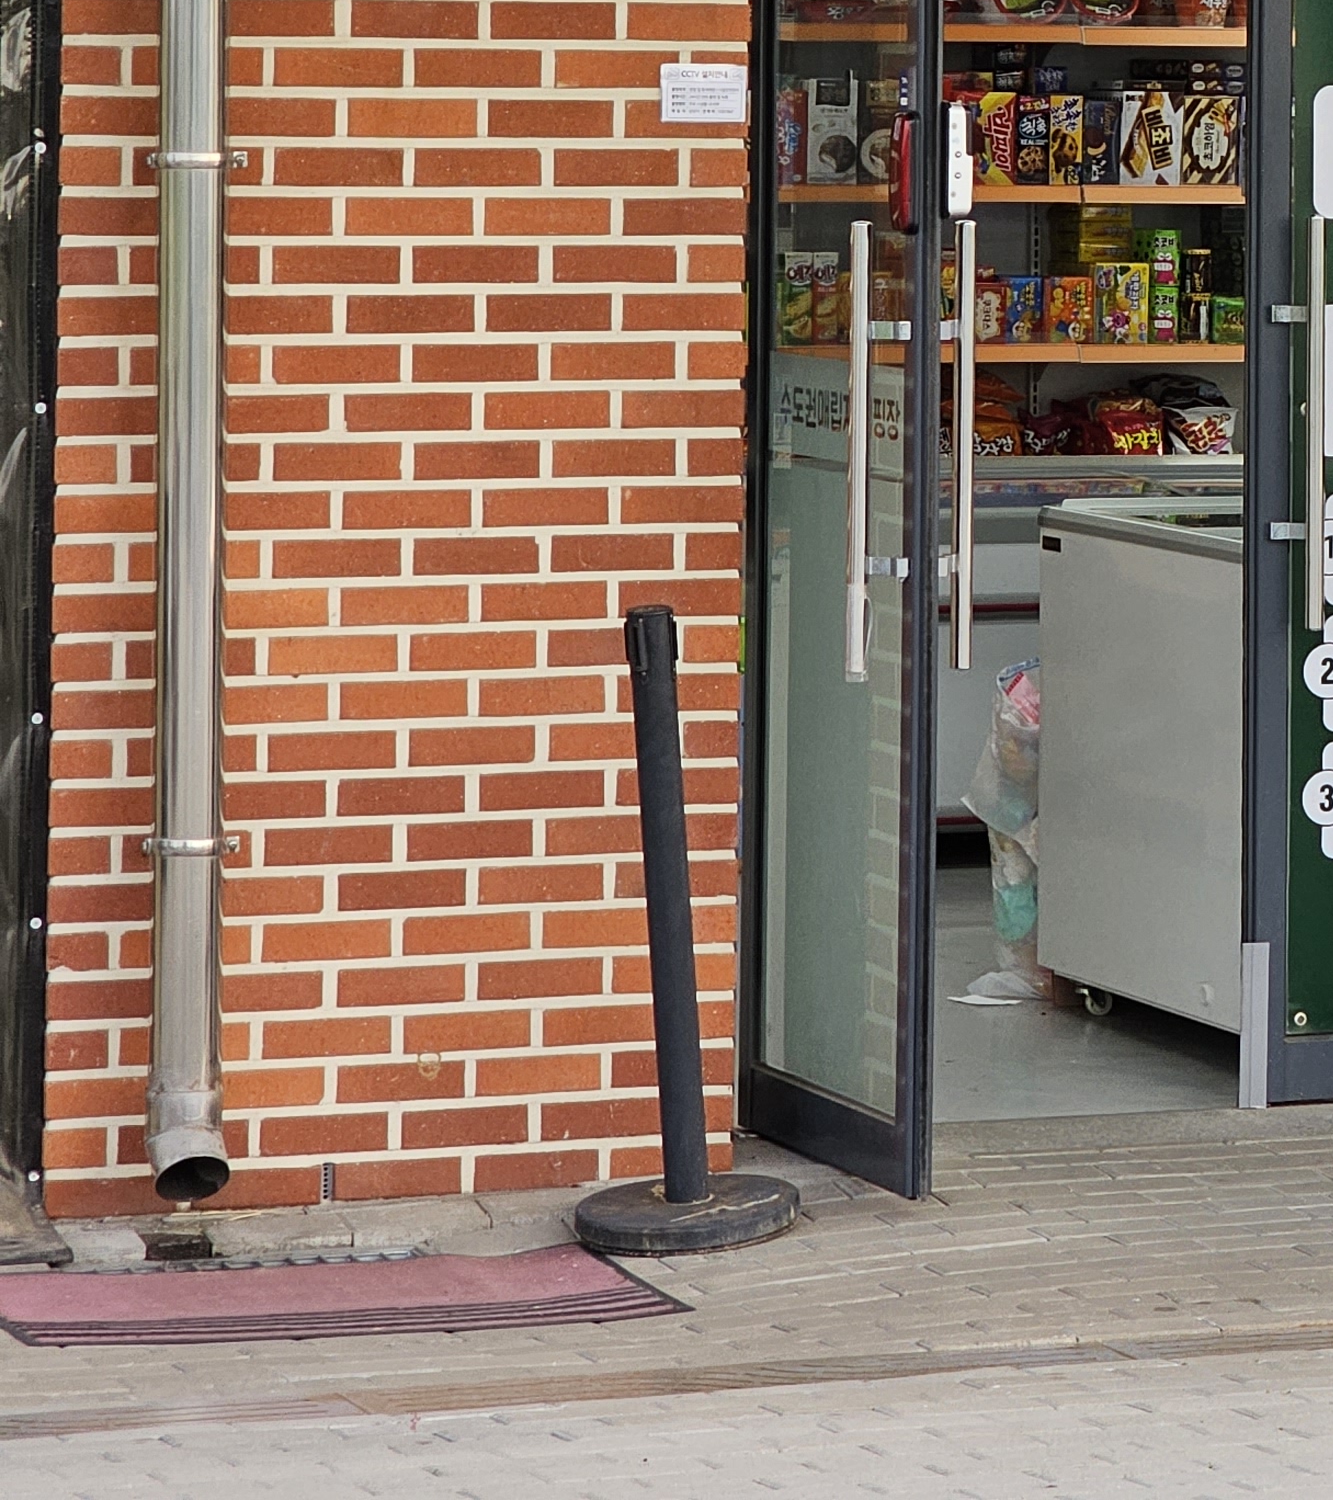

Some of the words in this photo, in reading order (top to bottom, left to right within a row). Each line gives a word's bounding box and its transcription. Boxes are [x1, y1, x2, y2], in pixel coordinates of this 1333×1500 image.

[983, 105, 1013, 173] 빅파이
[872, 397, 902, 441] 핑장
[1324, 534, 1333, 559] 1
